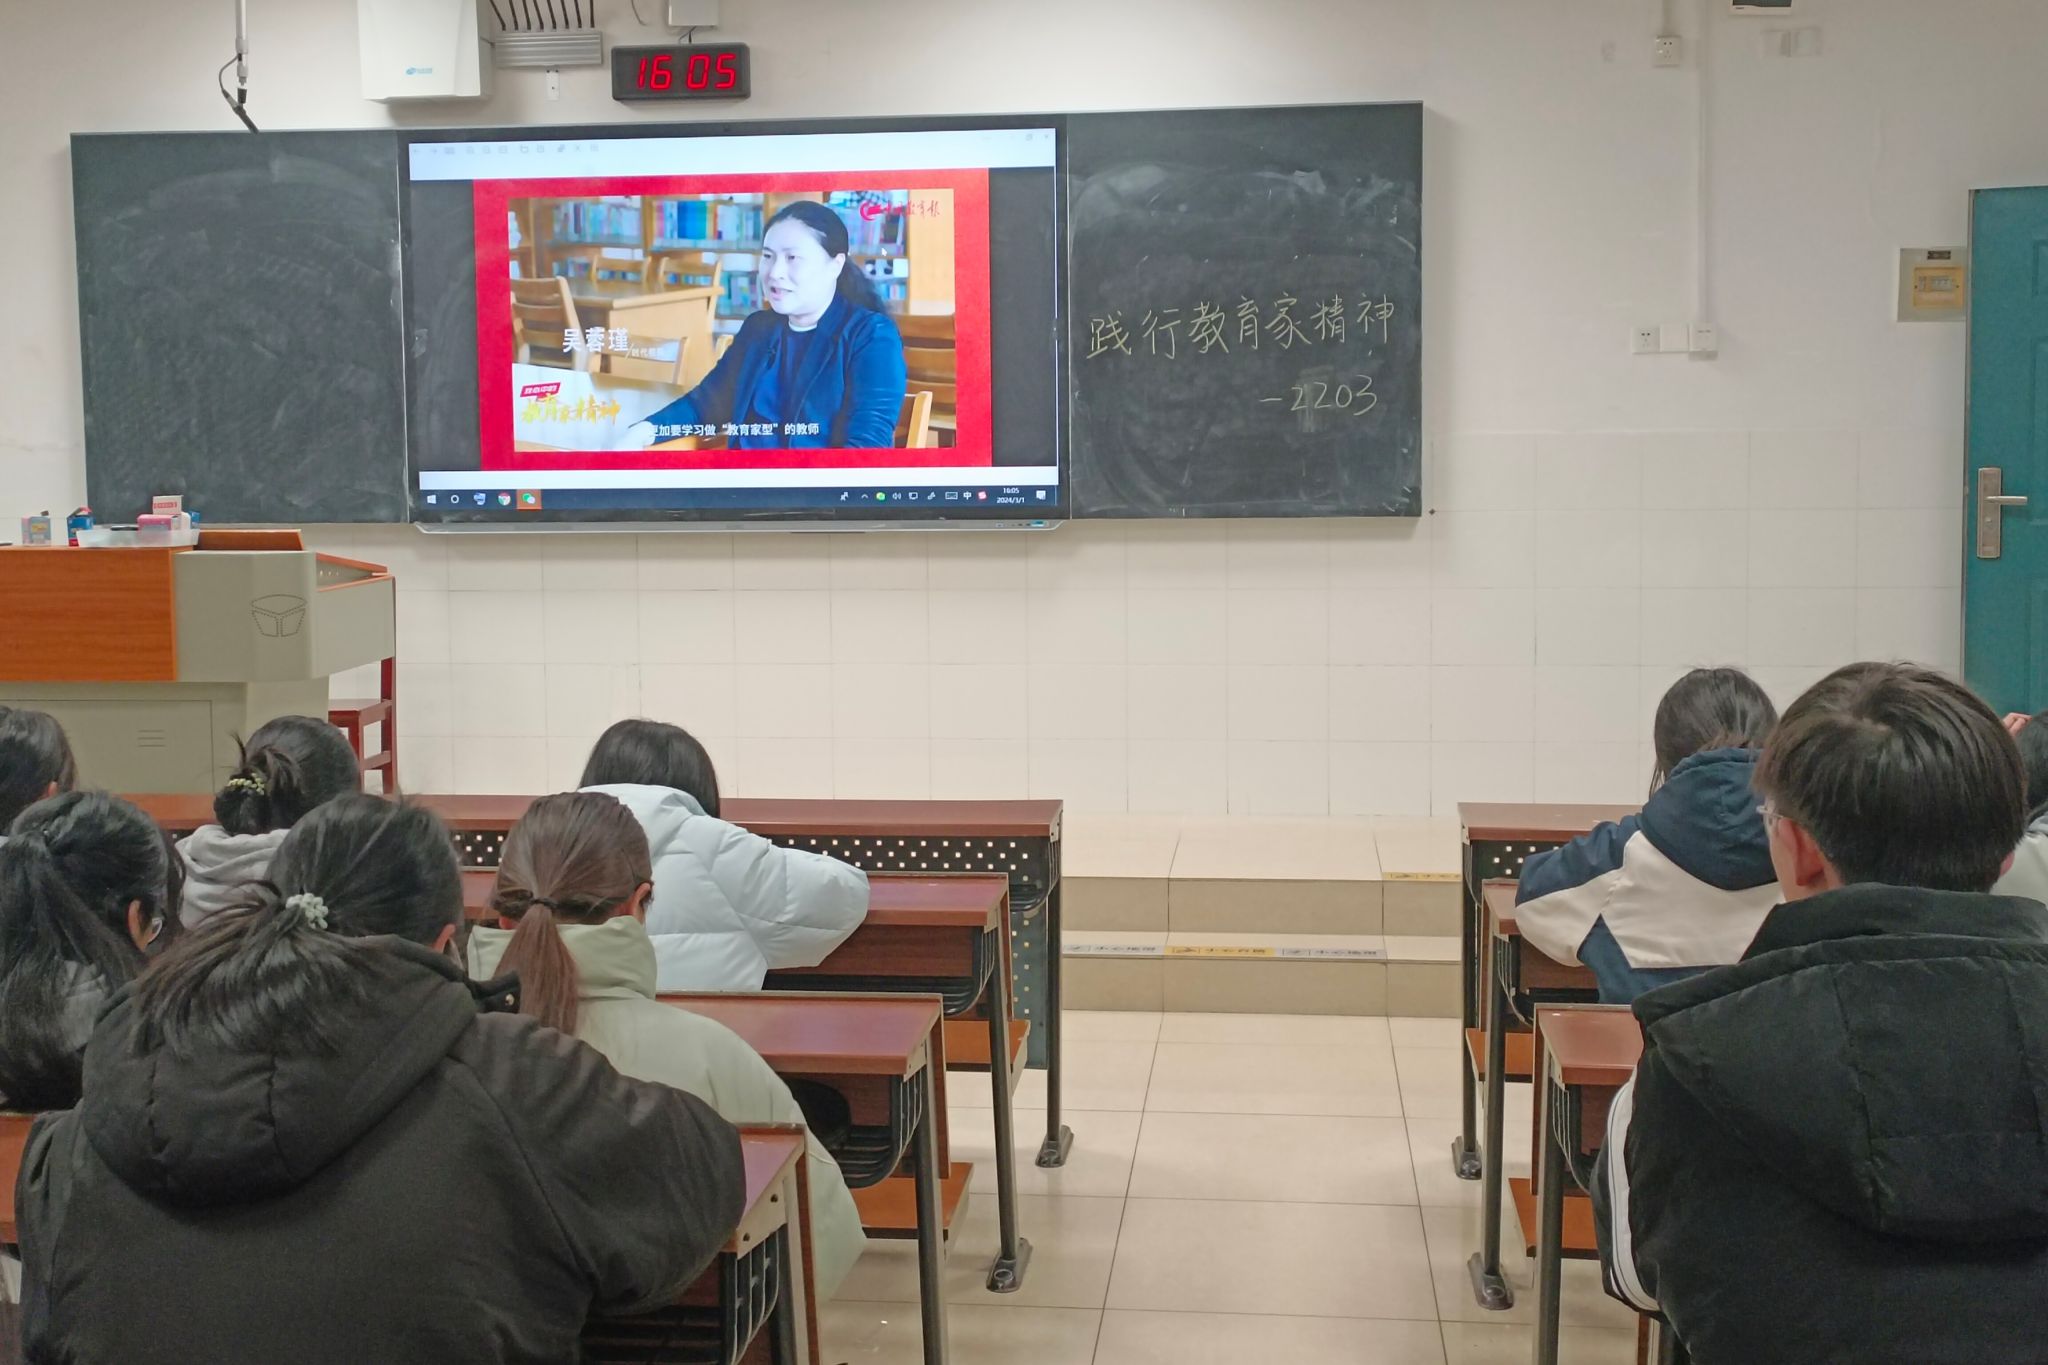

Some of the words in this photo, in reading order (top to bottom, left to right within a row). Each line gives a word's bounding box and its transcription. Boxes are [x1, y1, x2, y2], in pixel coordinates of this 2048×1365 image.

[1086, 292, 1395, 360] 践行教育家精神
